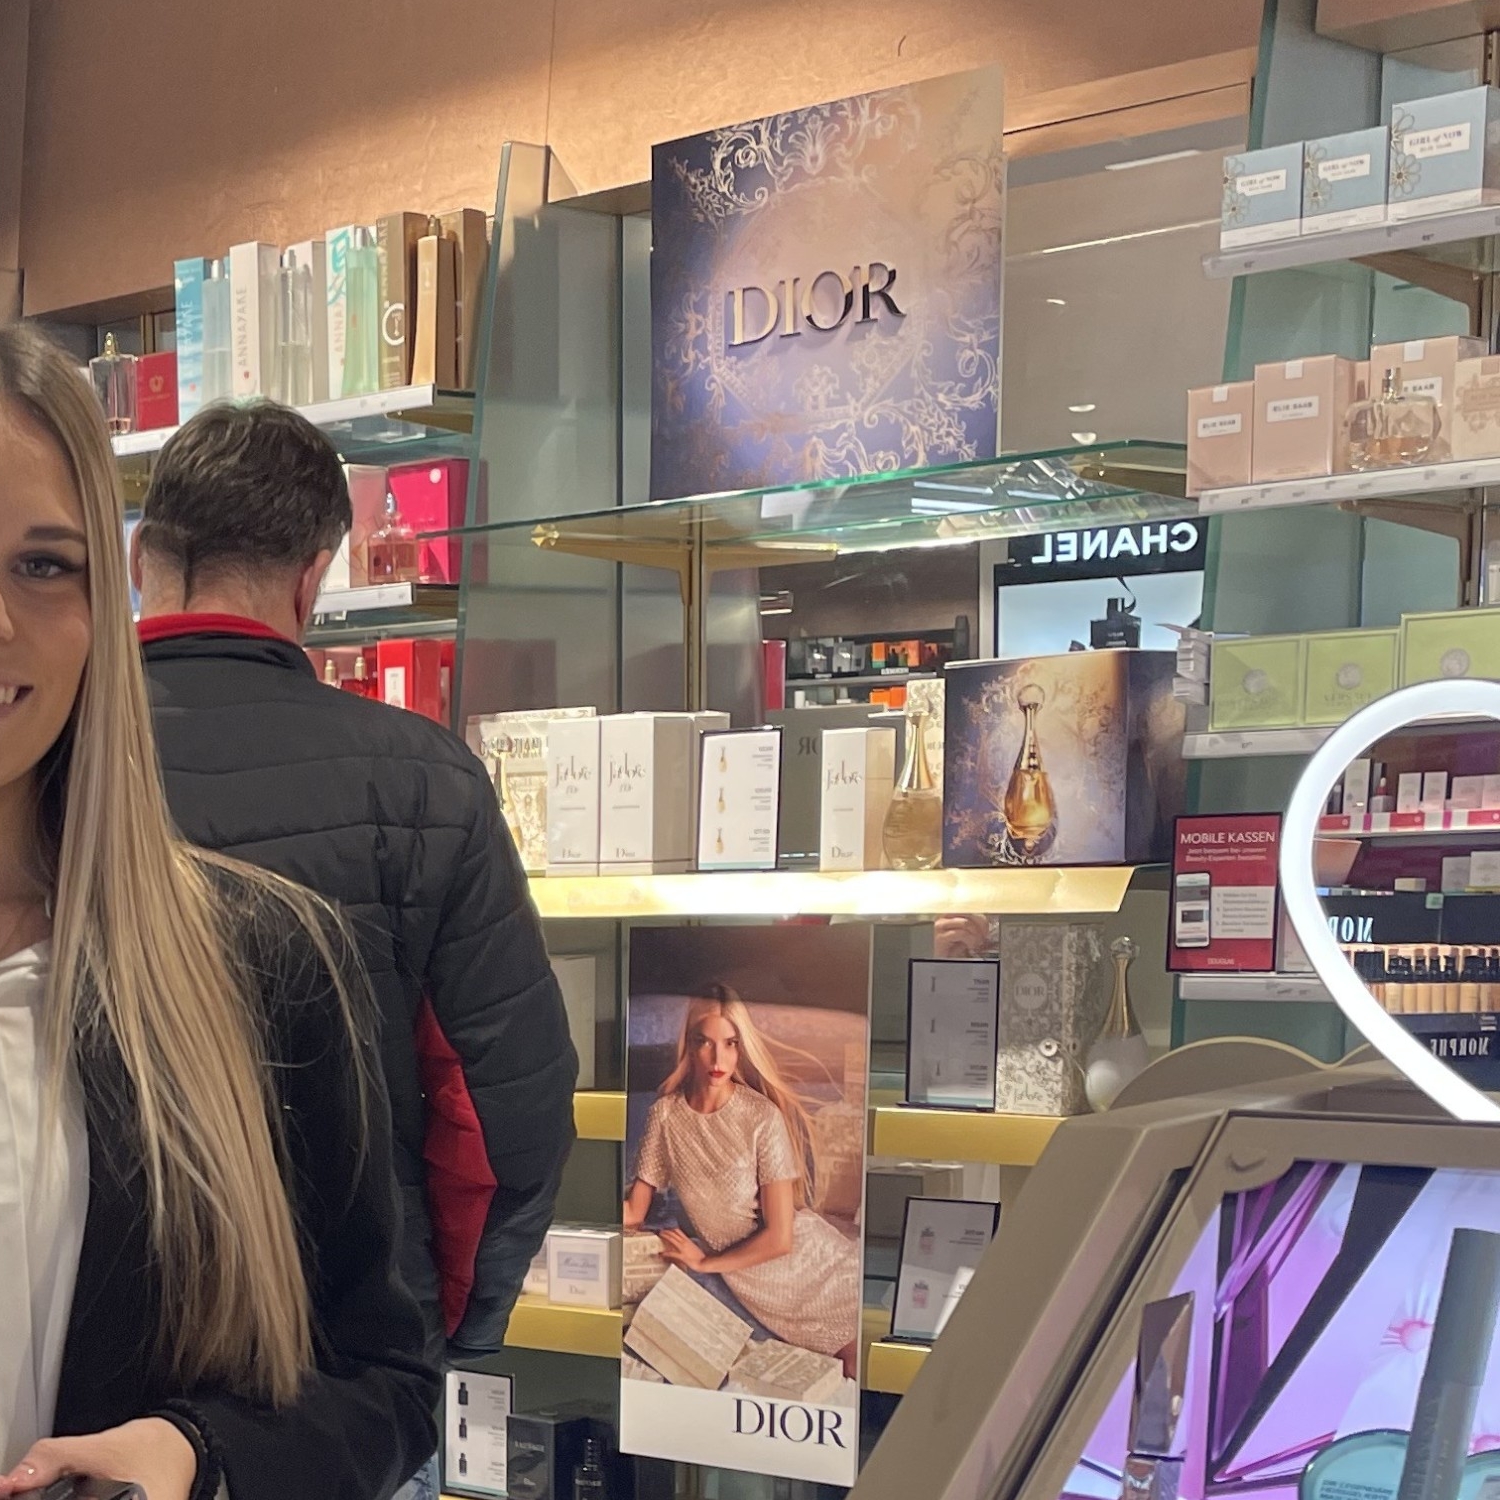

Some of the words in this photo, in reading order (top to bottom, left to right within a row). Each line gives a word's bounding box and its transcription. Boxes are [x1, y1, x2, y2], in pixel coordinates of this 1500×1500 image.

[236, 287, 248, 368] ANNAYAKE
[728, 261, 907, 348] DIOR
[1180, 832, 1226, 845] MOBILE
[1227, 831, 1276, 843] KASSEN
[731, 1398, 847, 1449] DIOR
